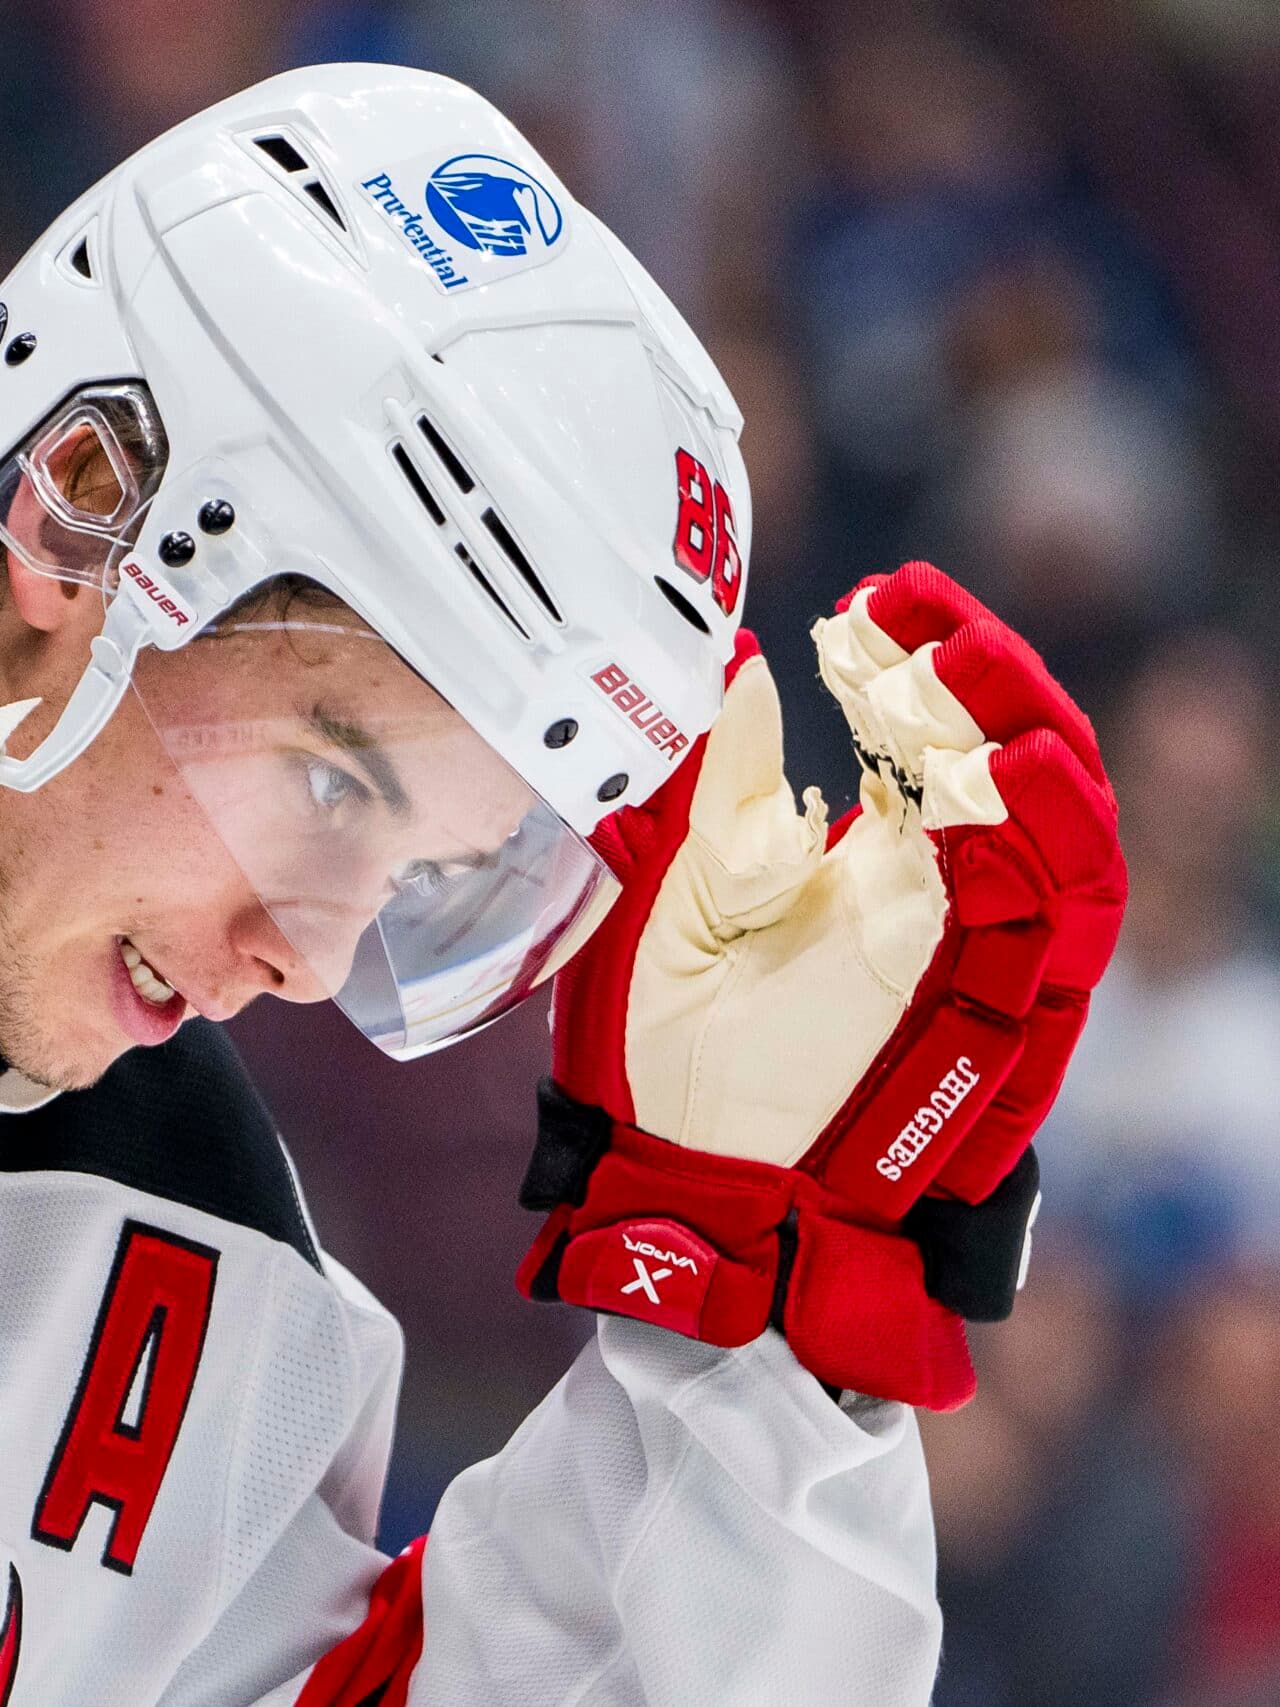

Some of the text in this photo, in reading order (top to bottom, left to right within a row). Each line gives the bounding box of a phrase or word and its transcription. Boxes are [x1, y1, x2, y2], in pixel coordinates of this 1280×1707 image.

[361, 172, 469, 290] Prudential
[673, 446, 742, 618] 86
[620, 1257, 673, 1305] X
[621, 1232, 699, 1277] VAPOR
[29, 1217, 222, 1578] A
